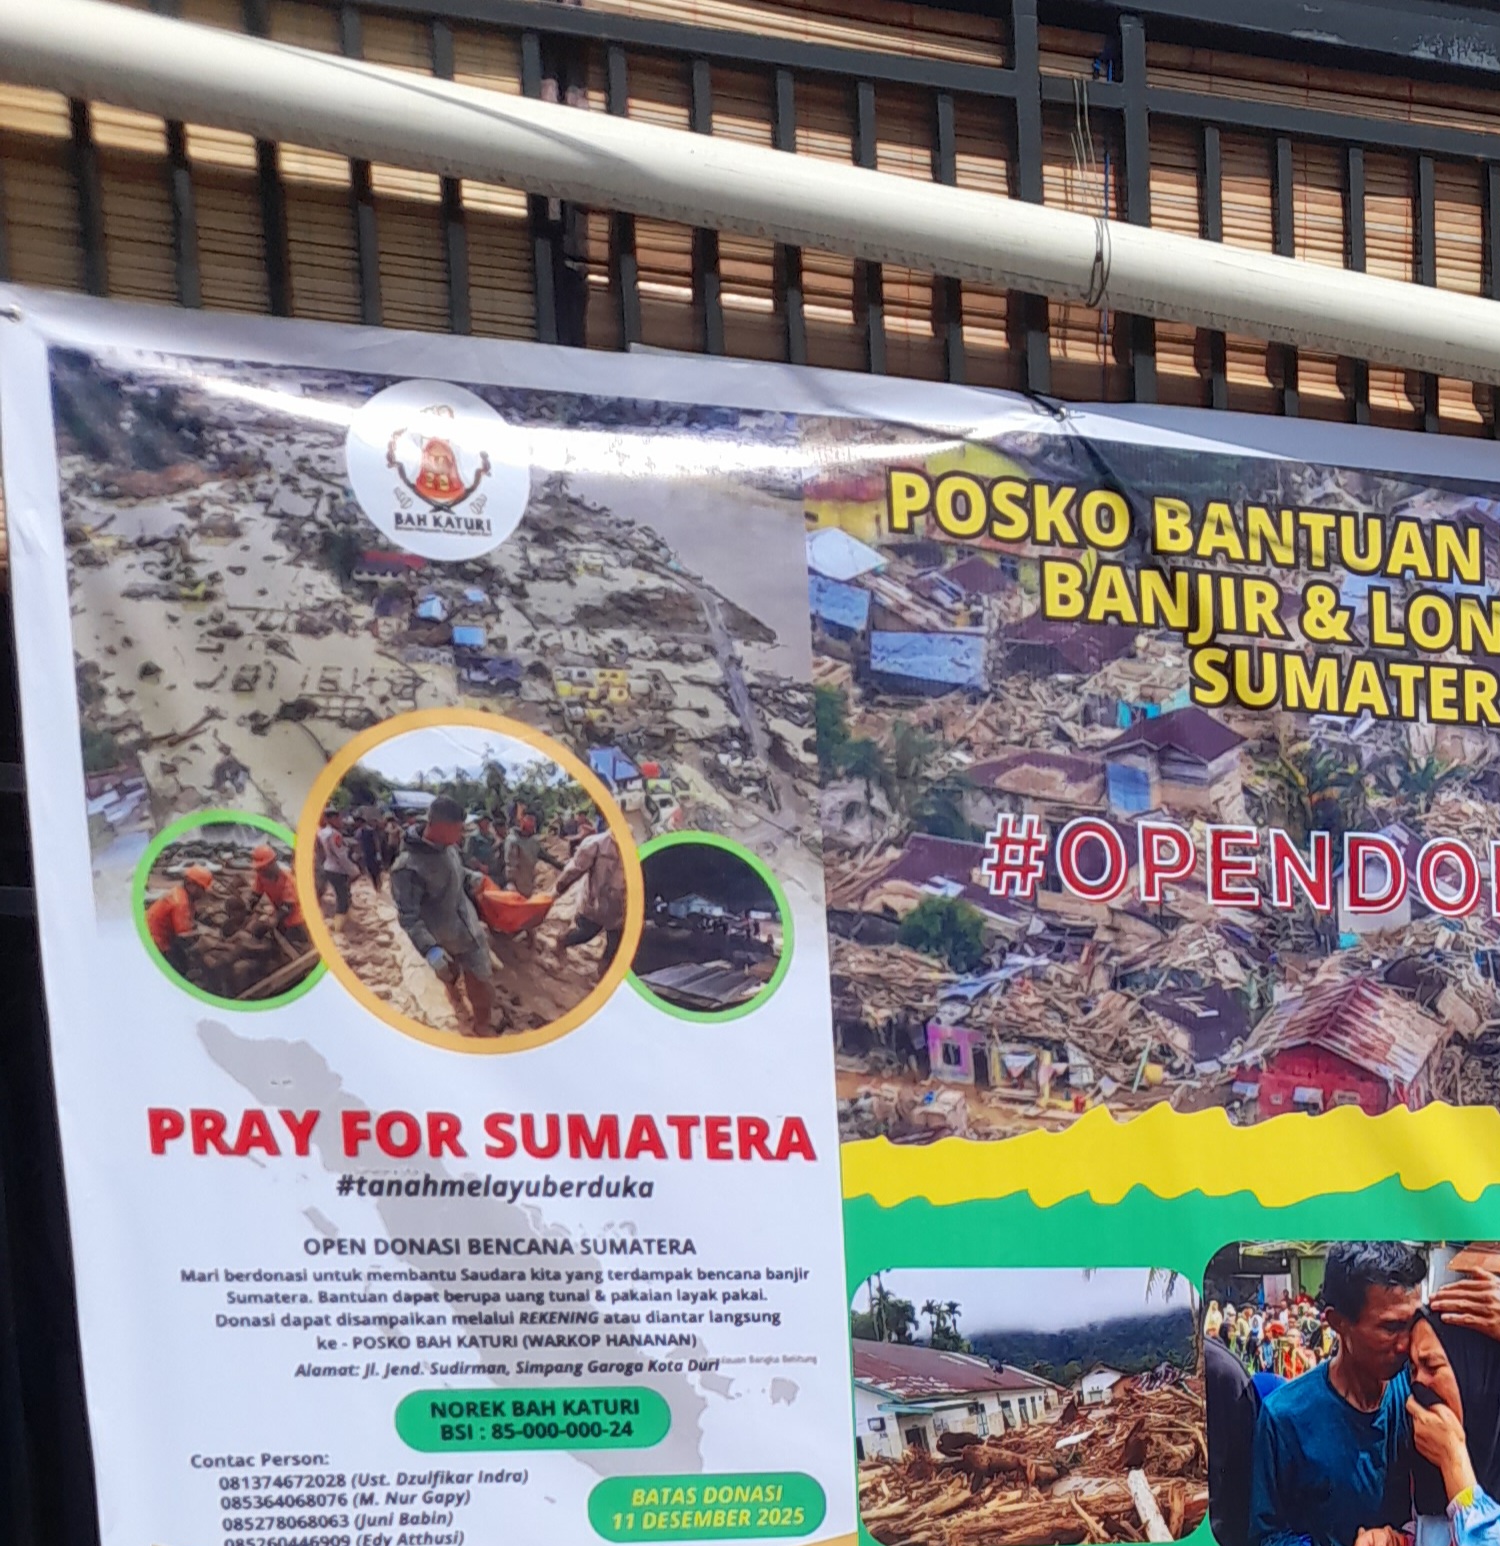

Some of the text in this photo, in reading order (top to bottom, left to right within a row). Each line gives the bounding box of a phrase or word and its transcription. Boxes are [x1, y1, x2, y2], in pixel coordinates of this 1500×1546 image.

[394, 512, 492, 531] BAH KATURI
[888, 468, 1133, 550] POSKO
[1152, 497, 1484, 584] BANTUAN
[1040, 556, 1291, 646] BANJIR
[1302, 580, 1358, 645] &
[147, 1107, 817, 1161] PRAY FOR SUMATERA
[336, 1173, 655, 1204] #tanahmelayuberduka
[303, 1237, 698, 1256] OPEN DONASI BENCANA SUMATERA
[180, 1266, 810, 1284] Mari berdonasi untuk membantu Saudara kita yang terdampak bencana banjir
[226, 1287, 768, 1306] Sumatera. Bantuan dapat berupa uang tunai & pakaian layak pakai.
[215, 1310, 782, 1329] Donasi dapat disampaikan melalui REKENING atau diantar langsung
[316, 1336, 338, 1350] ke
[352, 1336, 411, 1350] POSKO
[416, 1335, 451, 1349] BAH
[456, 1334, 518, 1349] KATURI
[522, 1334, 601, 1350] (WARKOP
[605, 1333, 698, 1348] HANANAN)
[294, 1362, 360, 1377] Alamat:
[362, 1362, 380, 1379] Jl.
[383, 1362, 425, 1379] Jend.
[429, 1361, 510, 1377] Sudirman,
[515, 1361, 583, 1377] Simpang
[587, 1360, 644, 1376] Garoga
[647, 1359, 683, 1373] Kota
[687, 1359, 720, 1373] Duri
[429, 1398, 640, 1418] NOREK BAH KATURI
[440, 1424, 474, 1440] BSI
[491, 1421, 633, 1440] 85-000-000-24
[190, 1452, 330, 1469] Contac Person:
[218, 1468, 530, 1491] 081374672028 (Ust. Dzulfikar Indra)
[220, 1489, 471, 1510] 085364068076 (M. Nur Gapy)
[631, 1485, 783, 1506] BATAS DONASI
[222, 1511, 454, 1532] 085278068063 (Juni Babin)
[611, 1507, 805, 1530] 11 DESEMBER 2025
